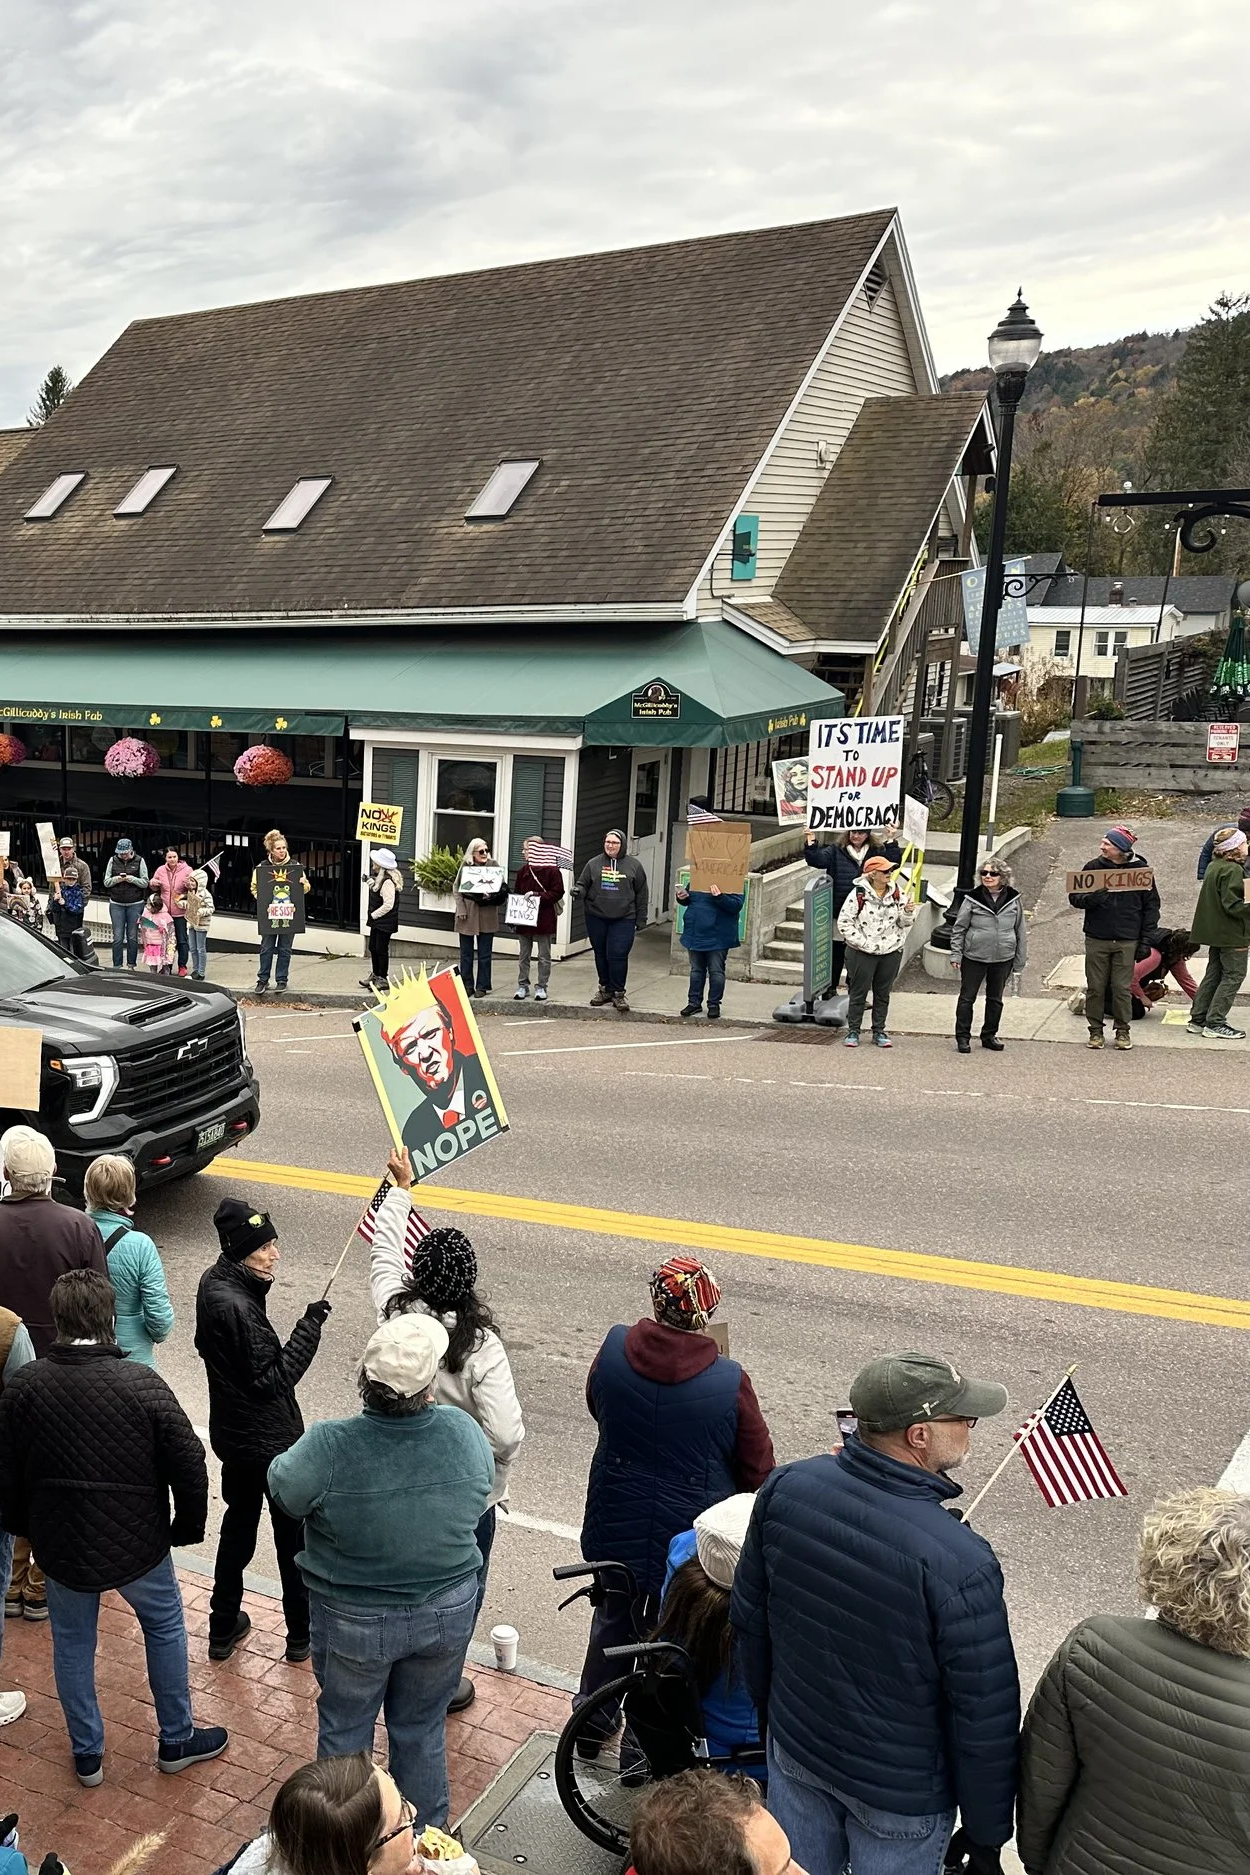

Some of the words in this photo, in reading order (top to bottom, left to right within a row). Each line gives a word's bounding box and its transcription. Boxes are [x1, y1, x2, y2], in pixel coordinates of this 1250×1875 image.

[58, 709, 82, 720] Irish
[84, 710, 103, 721] Pub
[658, 708, 672, 716] Pub
[789, 713, 799, 725] Pub
[817, 722, 852, 748] IT'S
[854, 720, 901, 744] TIME
[842, 750, 860, 762] TO
[811, 765, 867, 790] STAND
[871, 766, 899, 788] UP
[839, 791, 861, 803] FOR
[360, 808, 381, 821] NO
[809, 803, 899, 829] DEMOCRACY
[361, 821, 397, 834] KINGS
[1073, 874, 1095, 890] NO
[1104, 871, 1152, 888] KINGS
[270, 906, 295, 917] RESIST
[509, 909, 535, 921] KINGS
[411, 1107, 498, 1176] NOPE
